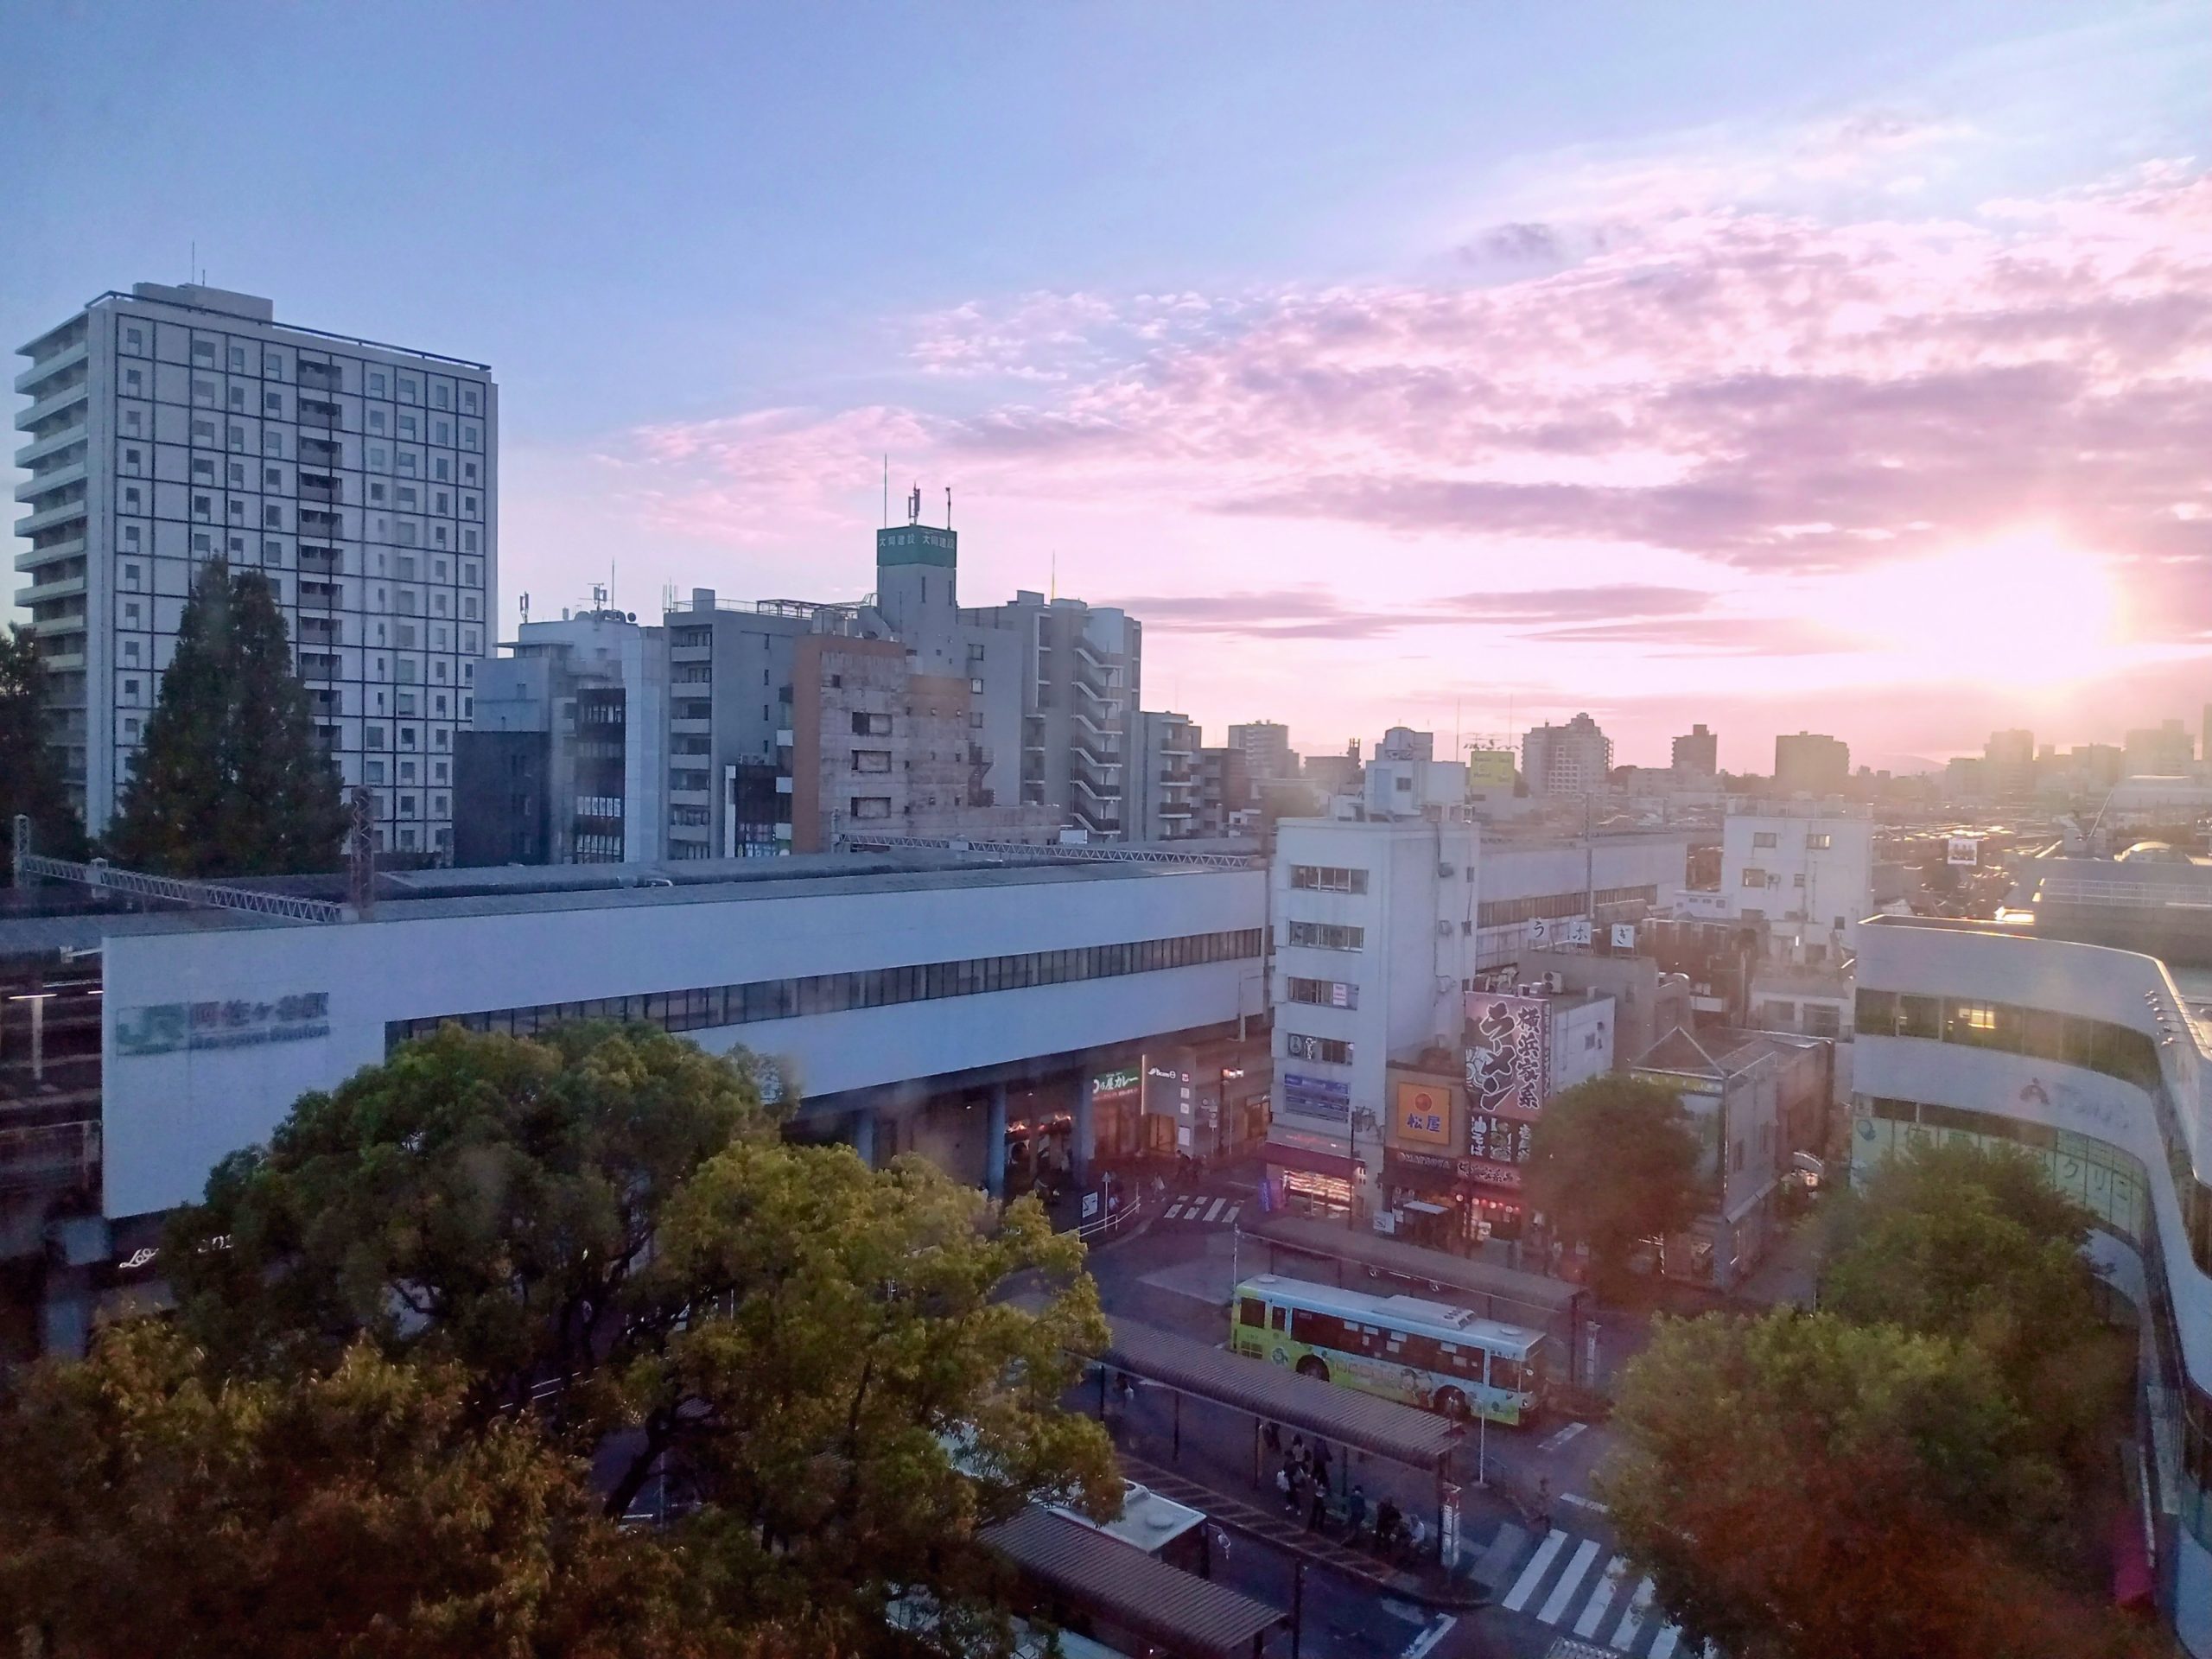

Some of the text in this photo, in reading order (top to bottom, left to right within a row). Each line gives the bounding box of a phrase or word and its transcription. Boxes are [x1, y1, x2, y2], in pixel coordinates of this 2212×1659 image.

[1479, 1001, 1517, 1112] ラーメン
[1516, 1005, 1541, 1109] 横浜家系
[1407, 1112, 1441, 1133] 松屋
[1470, 1115, 1487, 1157] 油そば
